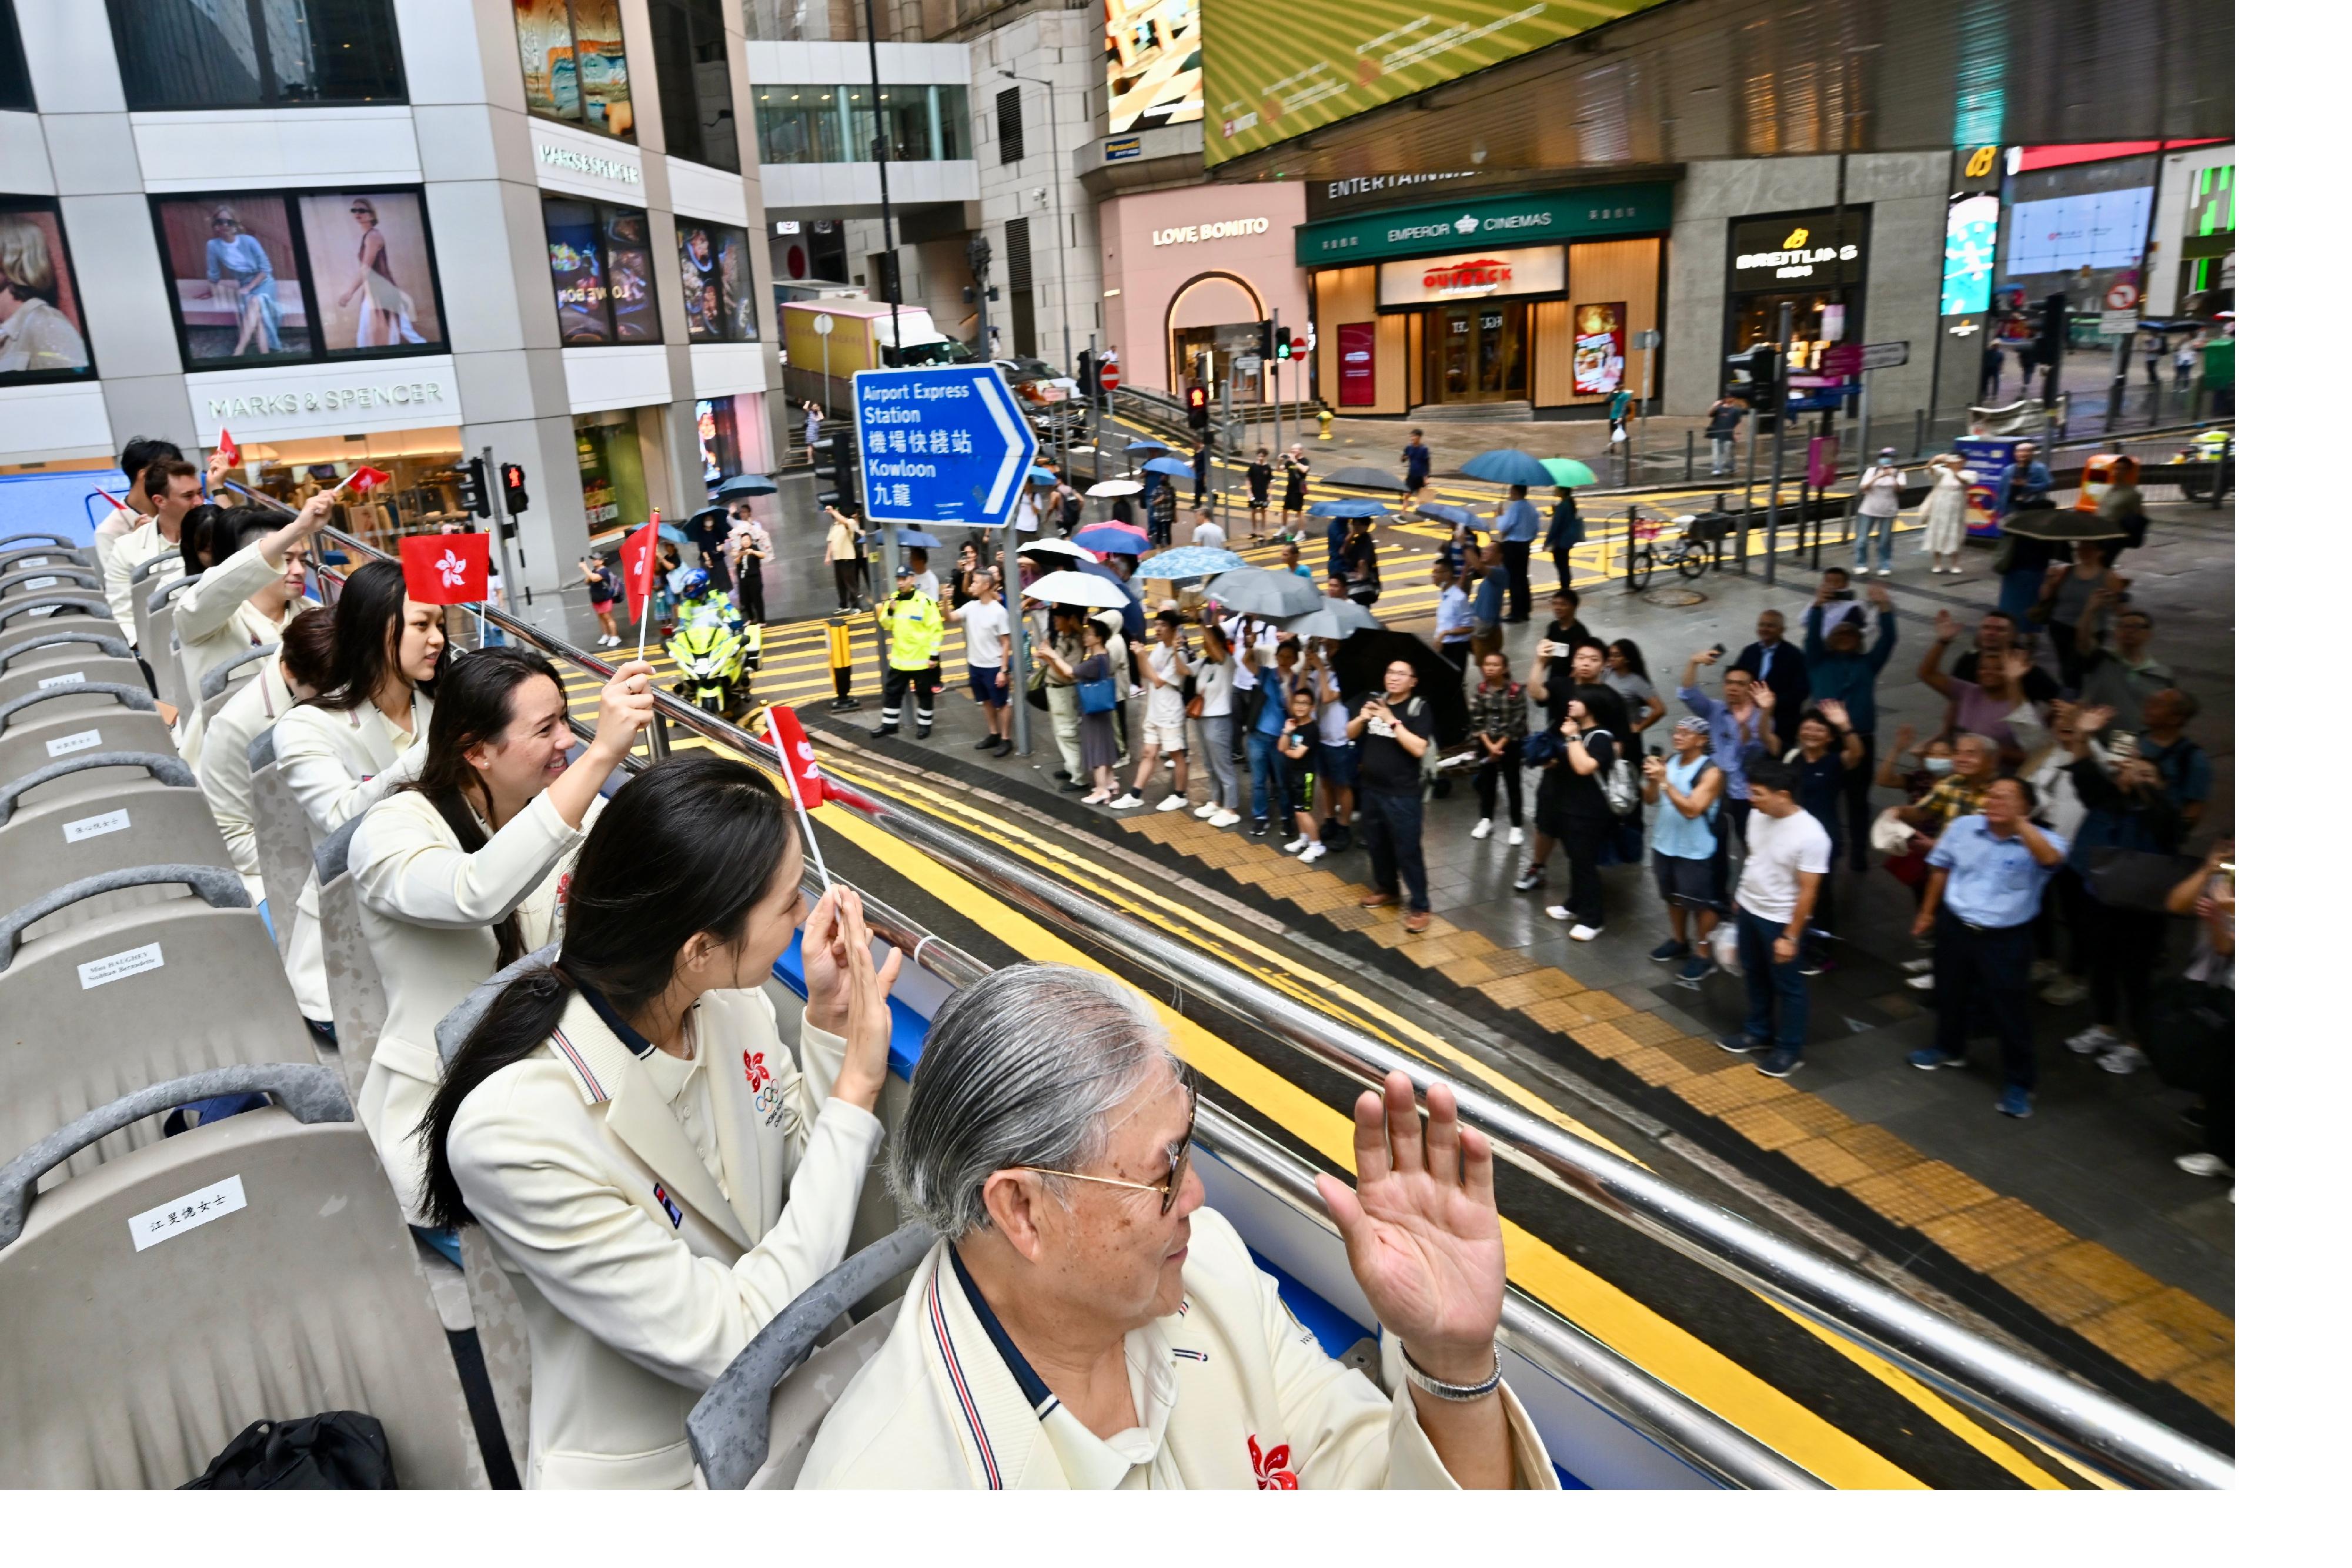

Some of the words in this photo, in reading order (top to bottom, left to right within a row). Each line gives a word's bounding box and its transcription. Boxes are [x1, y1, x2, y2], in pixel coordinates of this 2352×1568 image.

[1200, 217, 1269, 240] BONITO
[1387, 223, 1450, 242] EMPEROR
[1484, 212, 1552, 230] CINEMAS
[1423, 268, 1512, 287] OUTBACK
[208, 394, 299, 420] MARKS
[305, 392, 320, 411] &
[324, 383, 443, 409] SPENCER
[863, 384, 910, 403] Airport
[913, 383, 970, 401] Express
[864, 406, 921, 424] Station
[868, 429, 972, 454] 機場快綫站
[868, 459, 937, 477] Kowloon
[874, 482, 912, 507] 九龍
